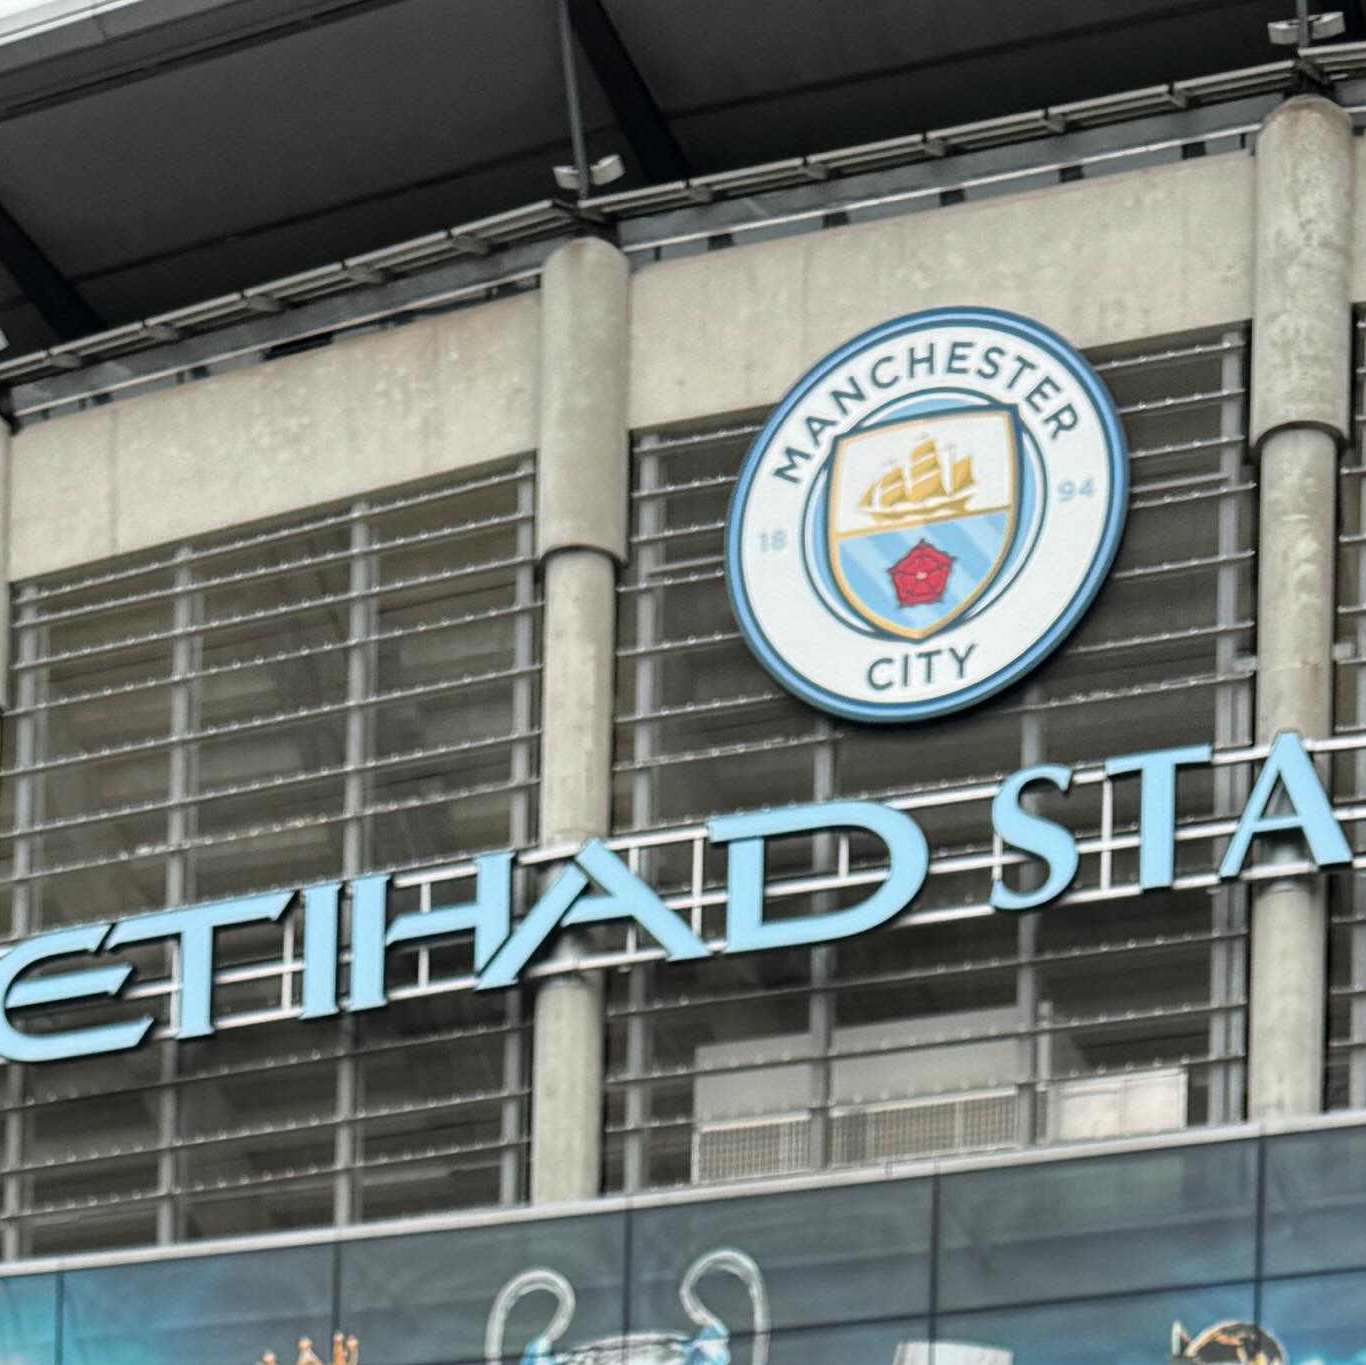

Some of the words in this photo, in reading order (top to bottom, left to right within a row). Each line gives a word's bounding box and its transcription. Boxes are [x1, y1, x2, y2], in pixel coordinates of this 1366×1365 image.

[773, 340, 1078, 485] MANCHESTER
[1057, 478, 1097, 503] 94
[758, 530, 788, 553] 18
[866, 643, 977, 691] CITY
